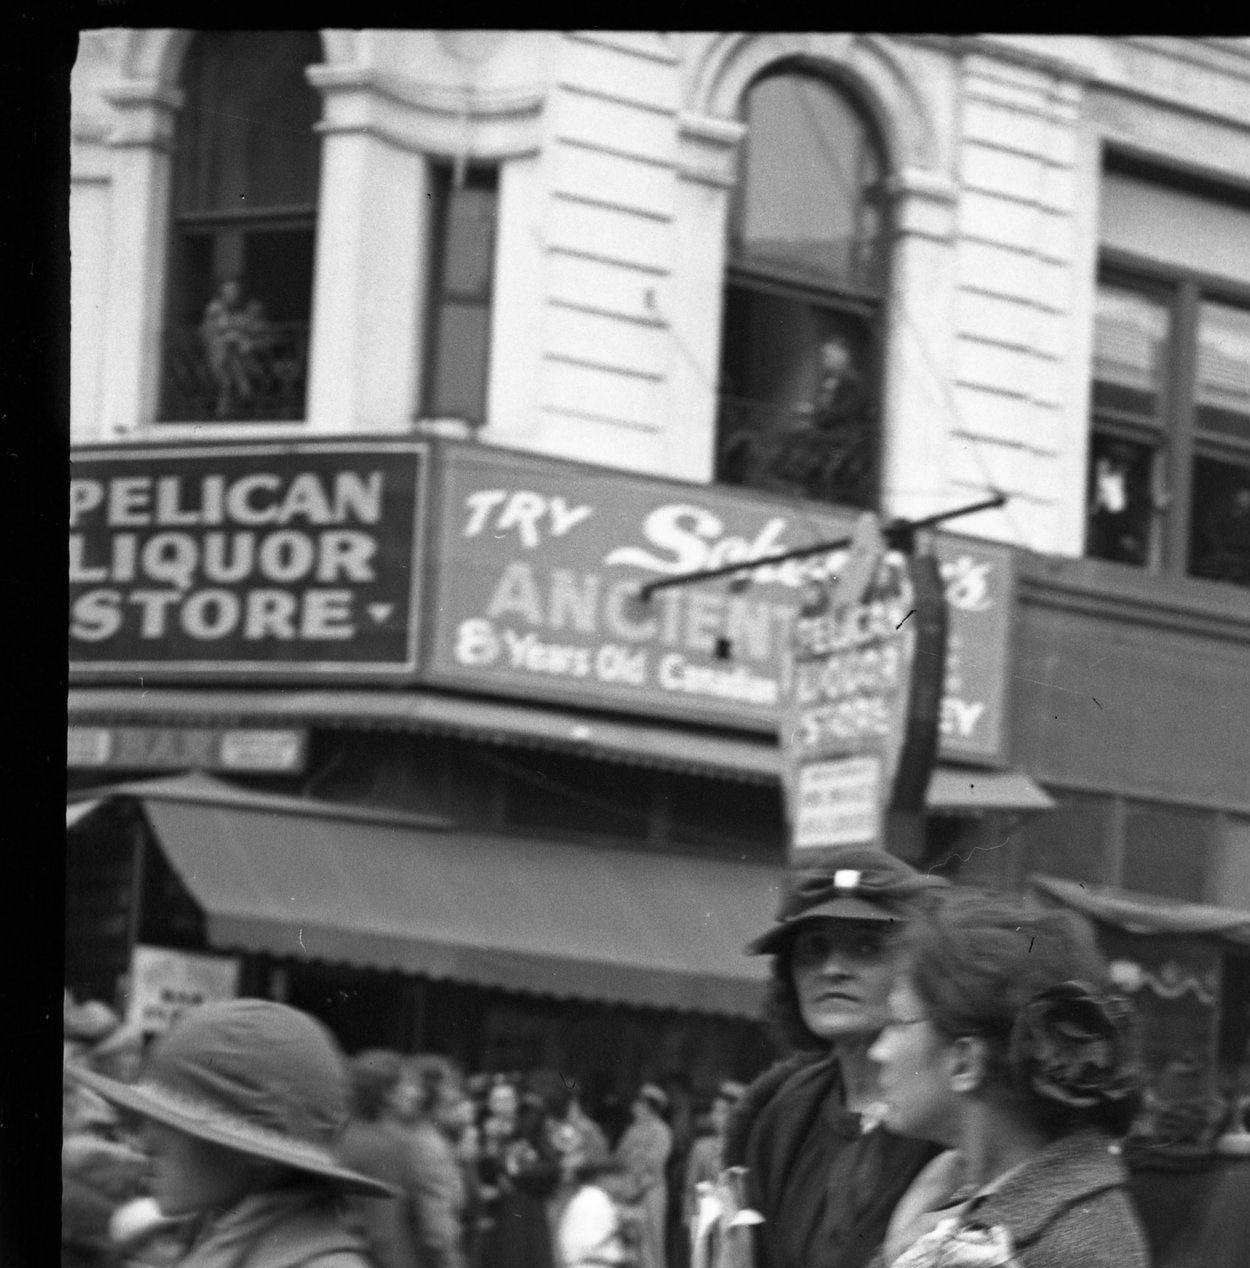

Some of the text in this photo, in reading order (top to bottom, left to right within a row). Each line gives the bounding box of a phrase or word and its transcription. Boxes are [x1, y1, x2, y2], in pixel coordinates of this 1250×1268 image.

[70, 471, 384, 528] PELICAN
[464, 488, 594, 548] TRY
[69, 529, 378, 592] LIQUOR
[70, 587, 355, 643] STORE
[595, 643, 647, 686] Old
